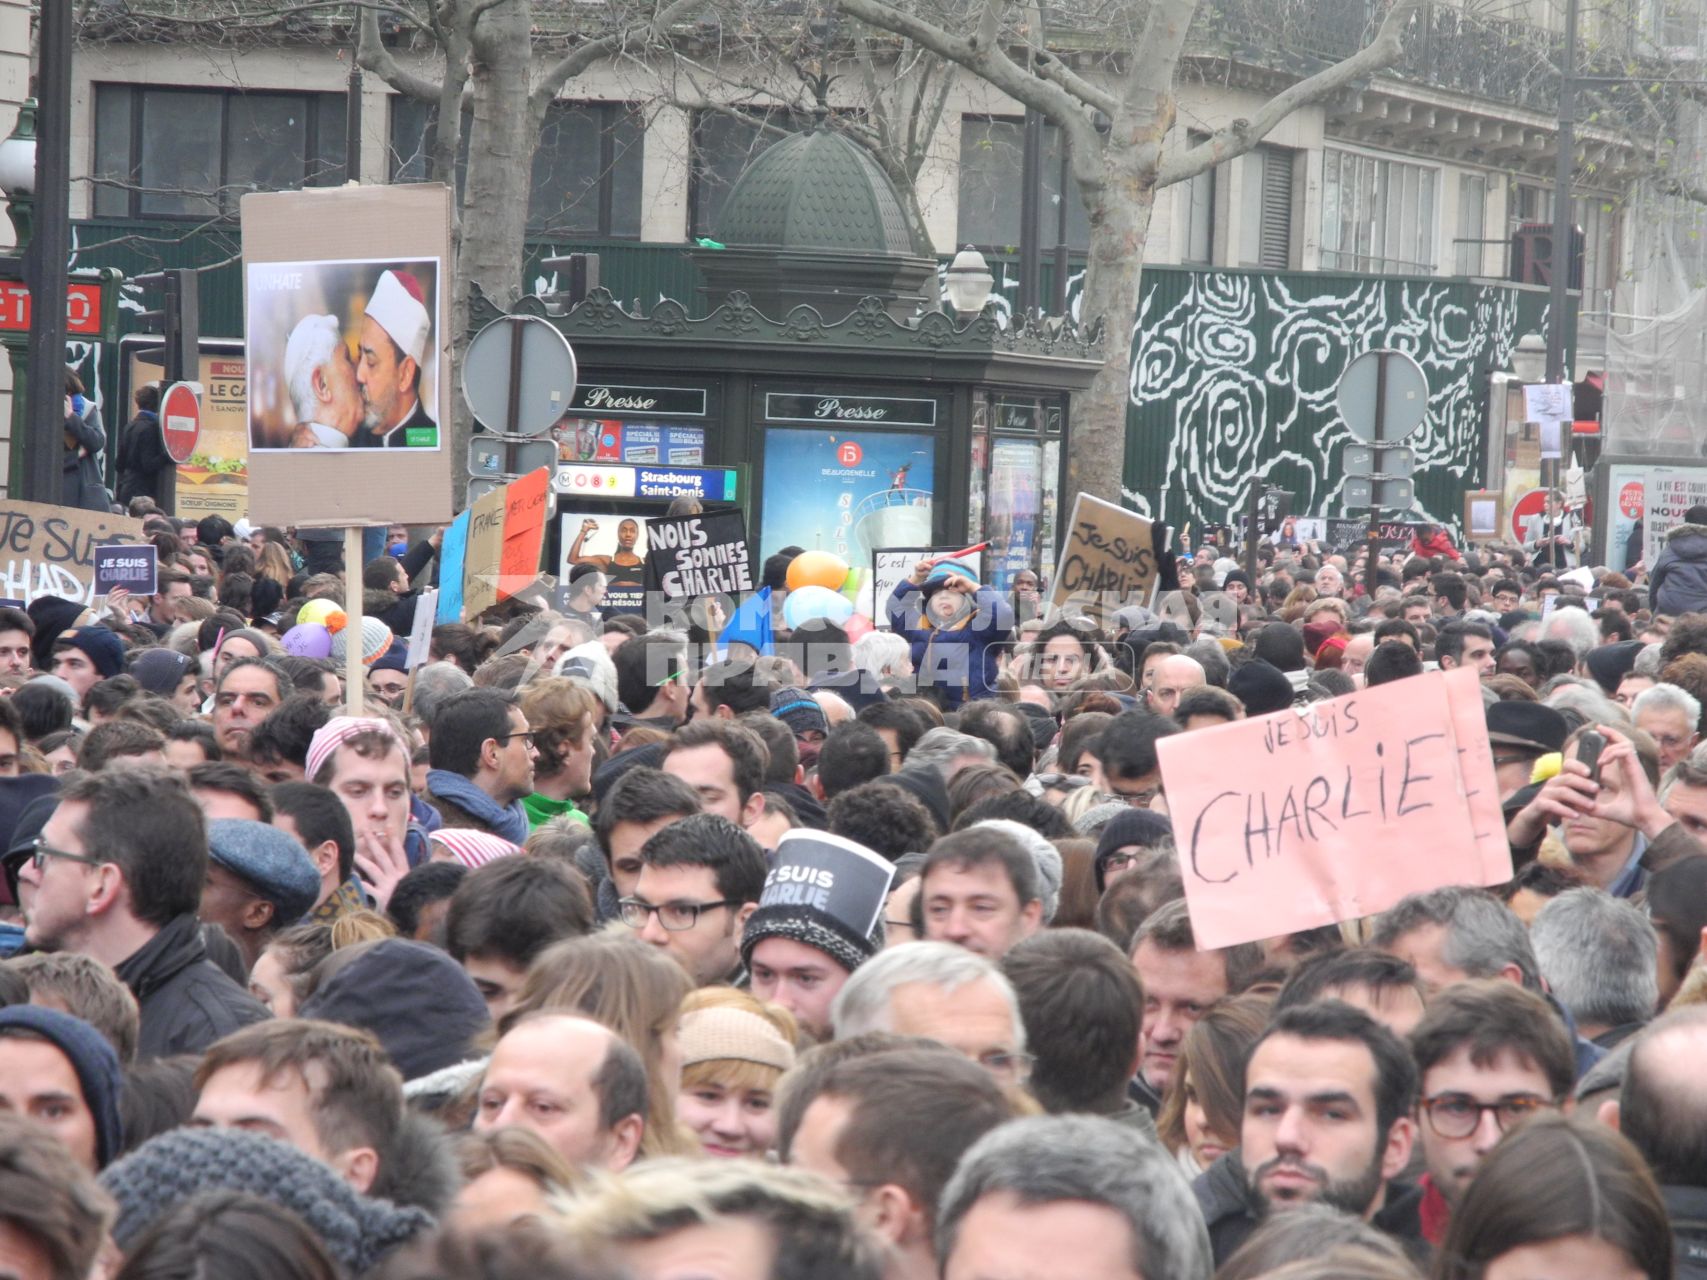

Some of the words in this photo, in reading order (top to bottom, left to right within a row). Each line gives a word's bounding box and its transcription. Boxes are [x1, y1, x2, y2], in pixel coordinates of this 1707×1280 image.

[210, 384, 226, 396] LE
[584, 387, 657, 409] Presse
[814, 397, 888, 419] Presse
[641, 471, 702, 486] Strasbourg
[821, 468, 876, 477] BEAUGRENELLE
[641, 485, 704, 498] Saint-Denis
[647, 518, 708, 551] NOUS
[100, 558, 115, 568] JE
[116, 558, 148, 568] SUIS
[100, 568, 149, 582] CHARLIE
[662, 563, 753, 597] CHARLIE
[608, 592, 629, 600] VOUS
[776, 865, 834, 888] SUIS
